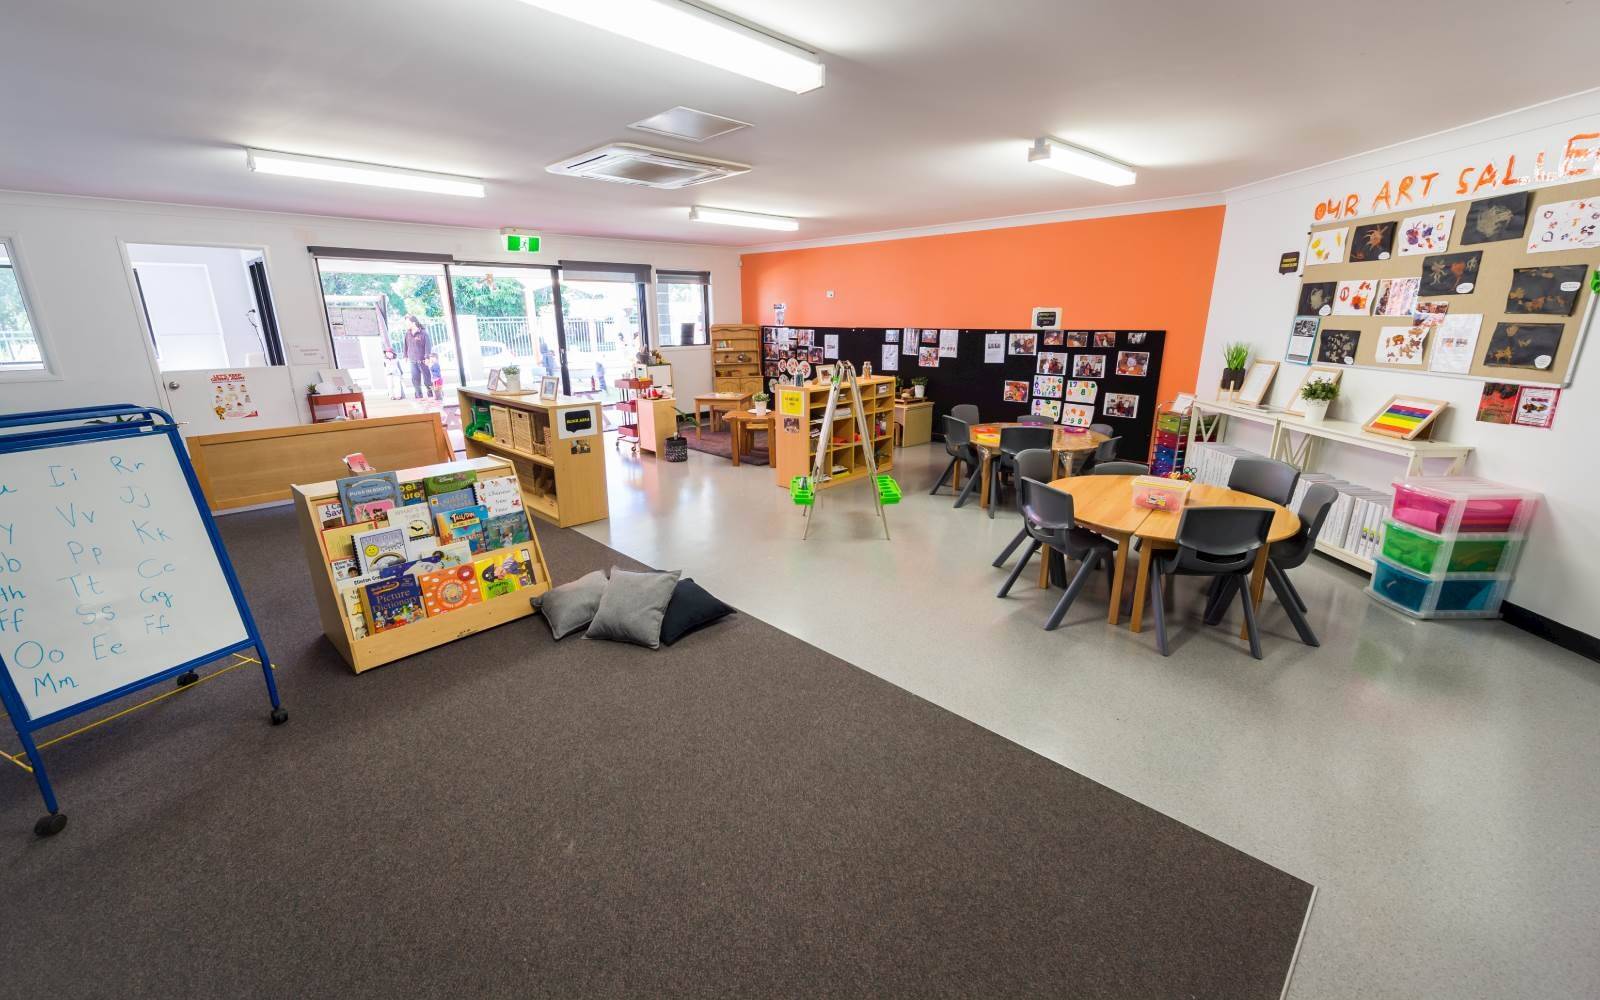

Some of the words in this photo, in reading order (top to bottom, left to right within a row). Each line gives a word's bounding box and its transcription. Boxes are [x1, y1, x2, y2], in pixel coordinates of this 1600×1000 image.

[1371, 171, 1440, 211] ART
[109, 455, 145, 473] Rr
[92, 632, 127, 660] Ee
[33, 672, 79, 697] Mm
